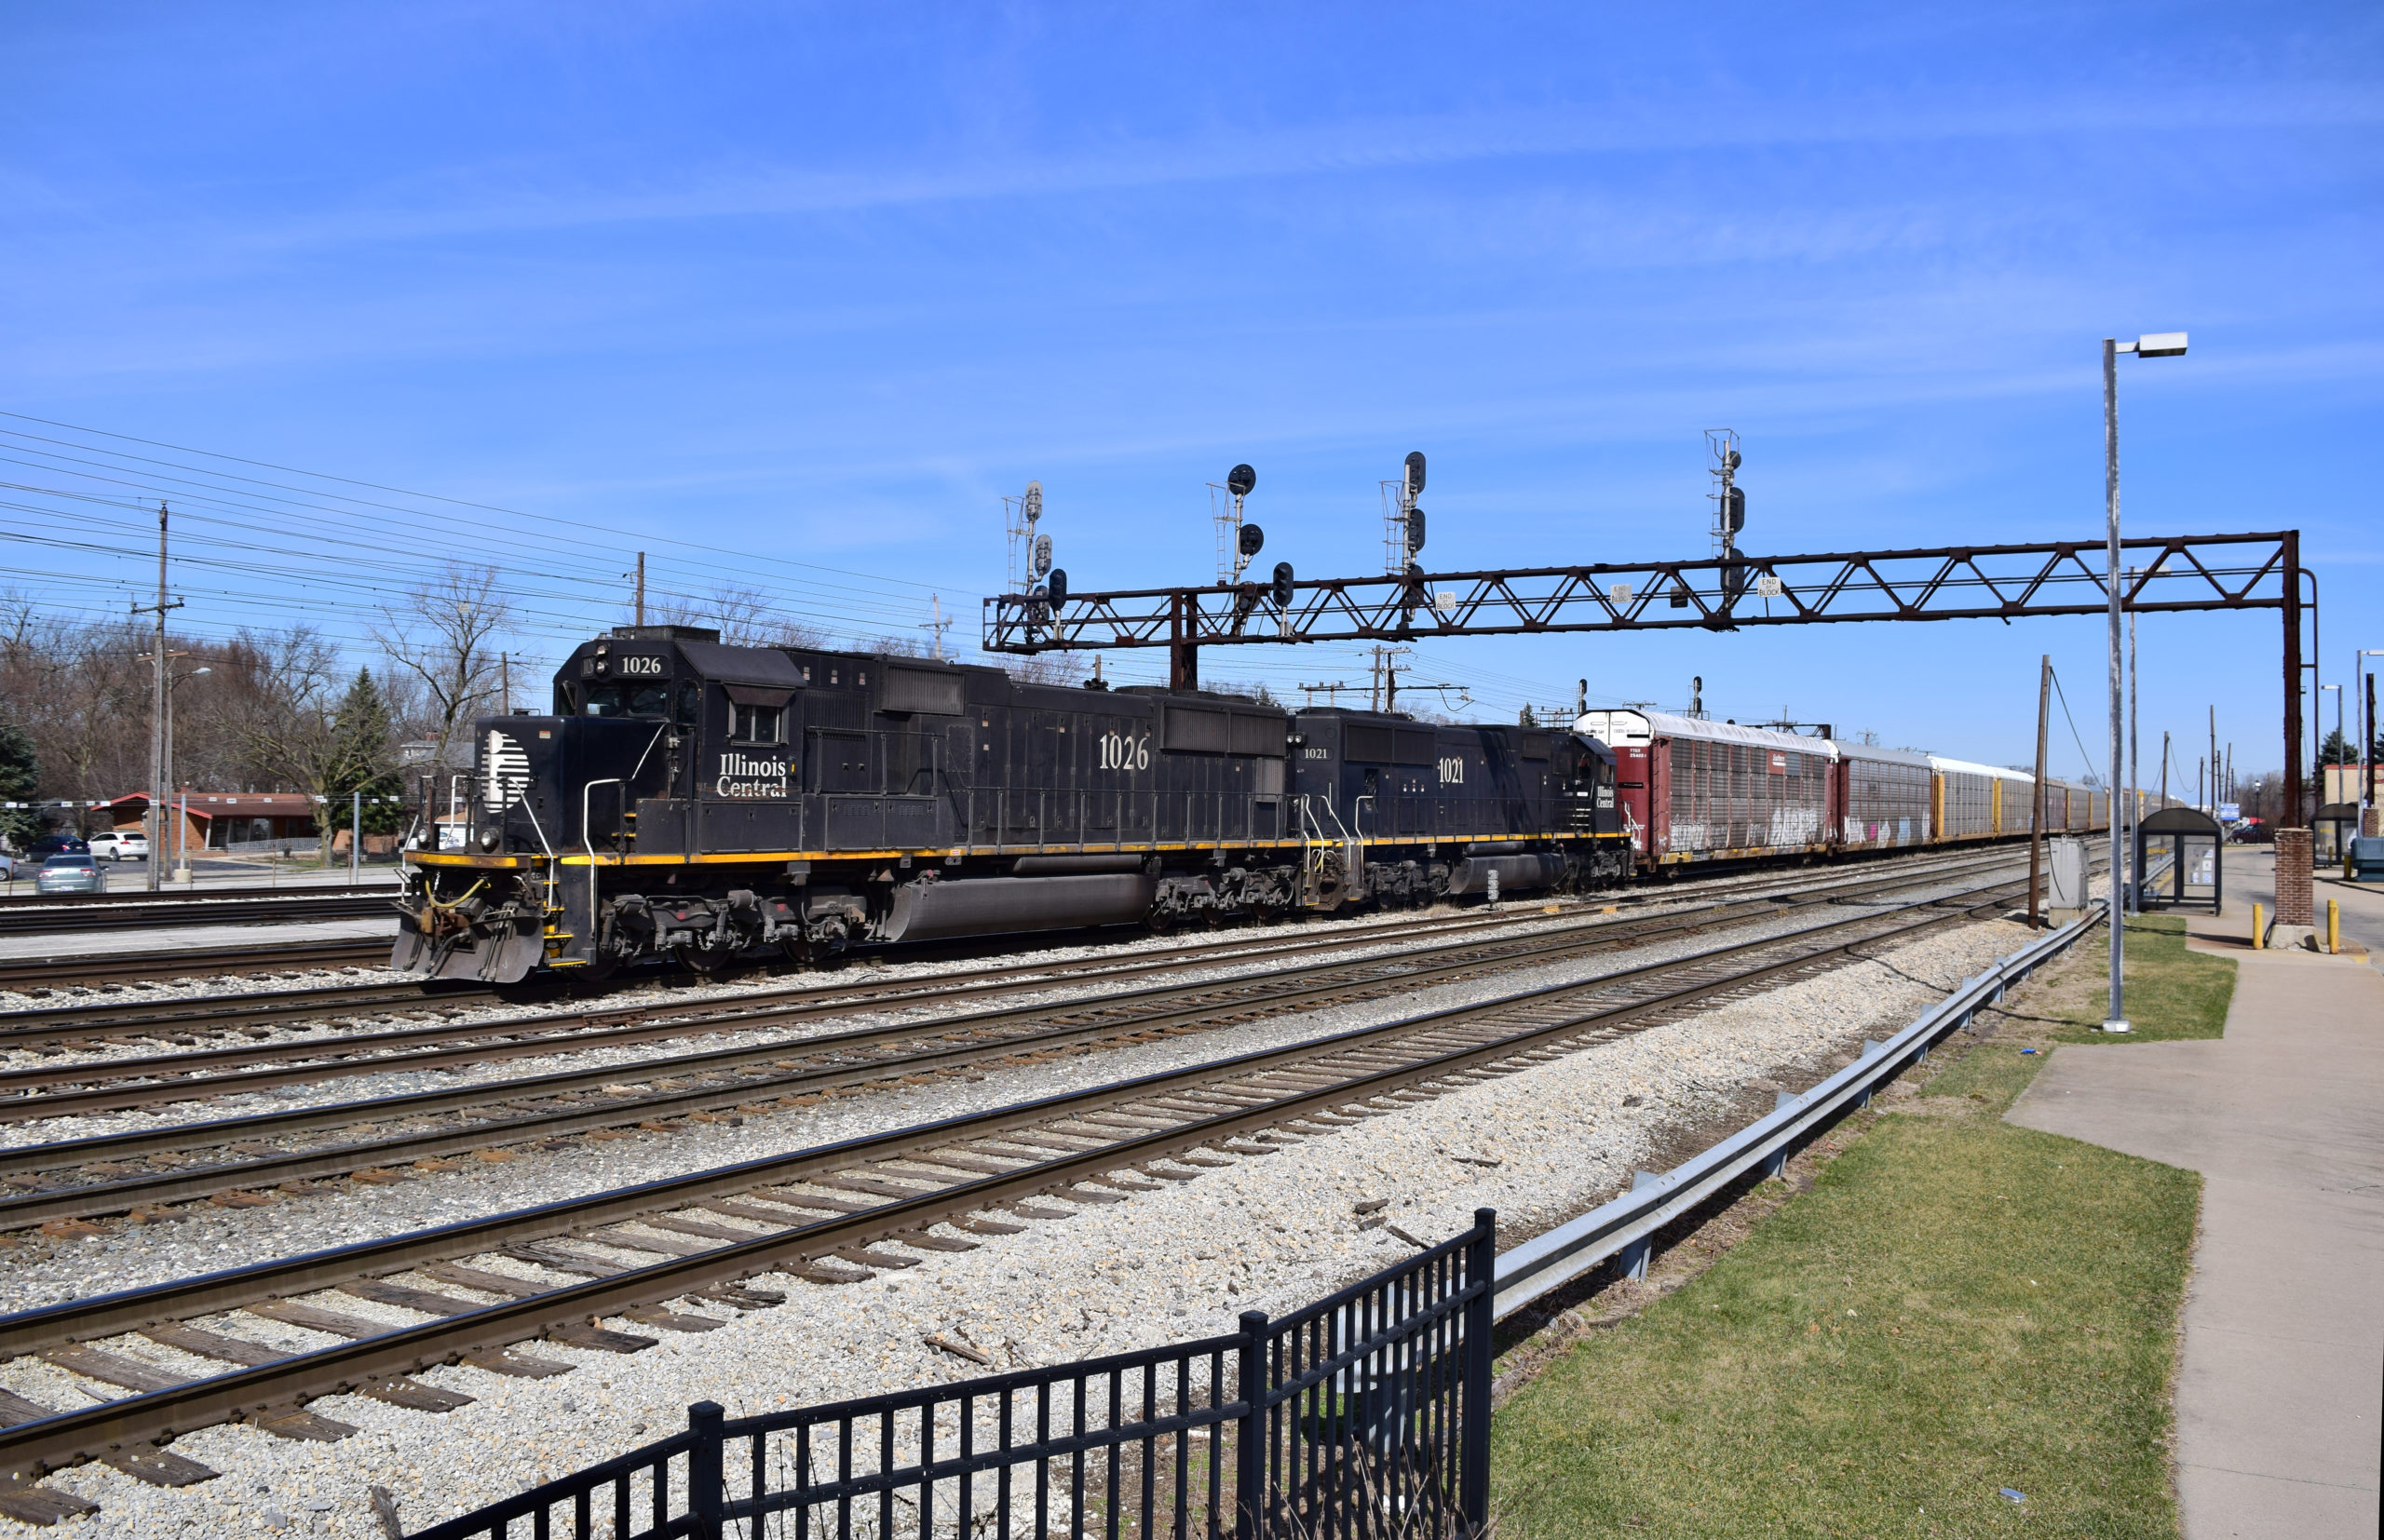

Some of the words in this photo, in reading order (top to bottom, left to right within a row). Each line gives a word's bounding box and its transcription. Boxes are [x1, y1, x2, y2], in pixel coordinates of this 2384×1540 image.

[622, 656, 661, 674] 1026
[1099, 734, 1149, 770] 1026
[1305, 748, 1328, 759] 1021
[719, 752, 786, 777] Illinois
[1439, 756, 1464, 784] 1021
[716, 776, 787, 798] Central
[1597, 785, 1614, 797] Illinois
[1596, 797, 1615, 808] Central
